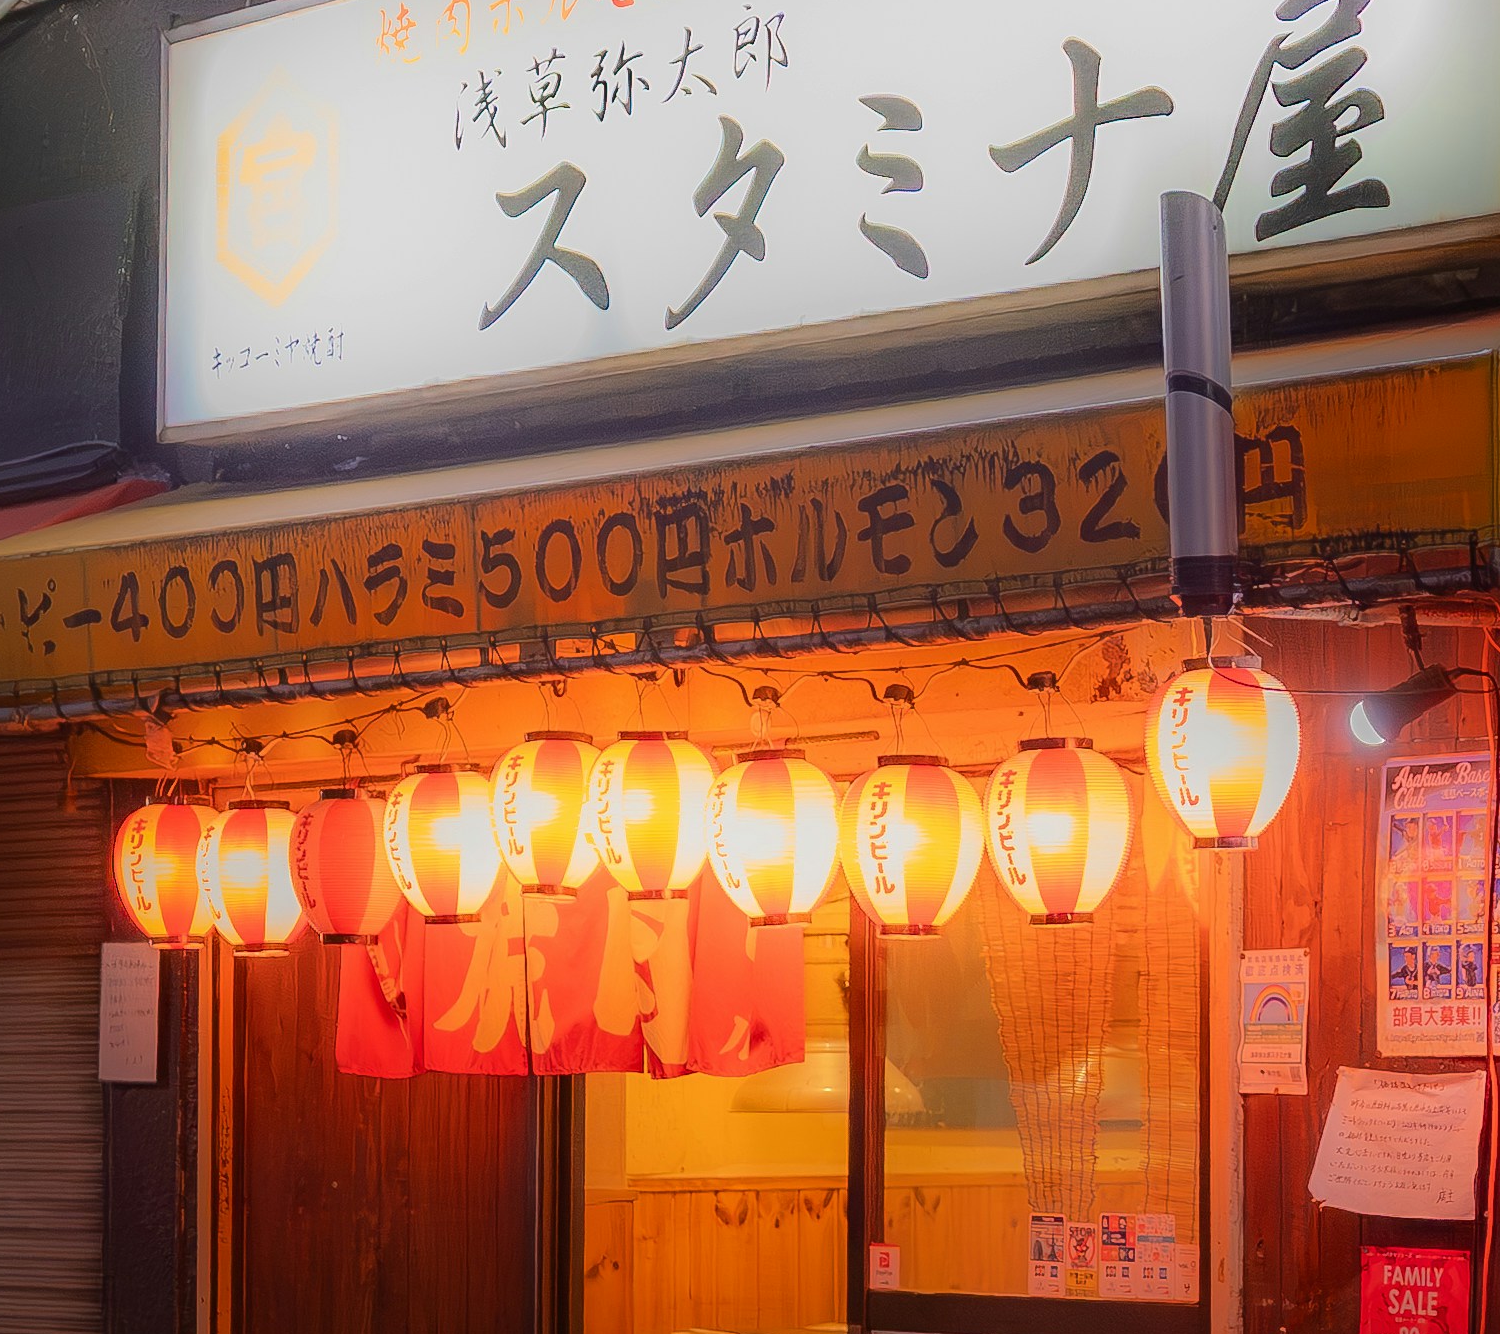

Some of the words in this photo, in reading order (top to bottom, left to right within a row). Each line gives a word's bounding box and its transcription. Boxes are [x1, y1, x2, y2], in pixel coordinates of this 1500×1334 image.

[454, 4, 790, 151] 浅草弥太郎
[210, 326, 345, 379] キッコーミヤ焼酎
[1169, 686, 1200, 809] キリンビール
[1391, 765, 1453, 791] Asakusa
[503, 753, 526, 859] キリンビール
[595, 758, 623, 867] キリンビール
[868, 779, 897, 896] キリンビール
[995, 768, 1027, 888] キリンビール
[1393, 786, 1427, 810] Club
[125, 816, 152, 915] キリンビール
[1393, 1005, 1482, 1027] 部員大募集!!
[1383, 1265, 1445, 1288] FAMILY
[1388, 1289, 1439, 1317] SALE
